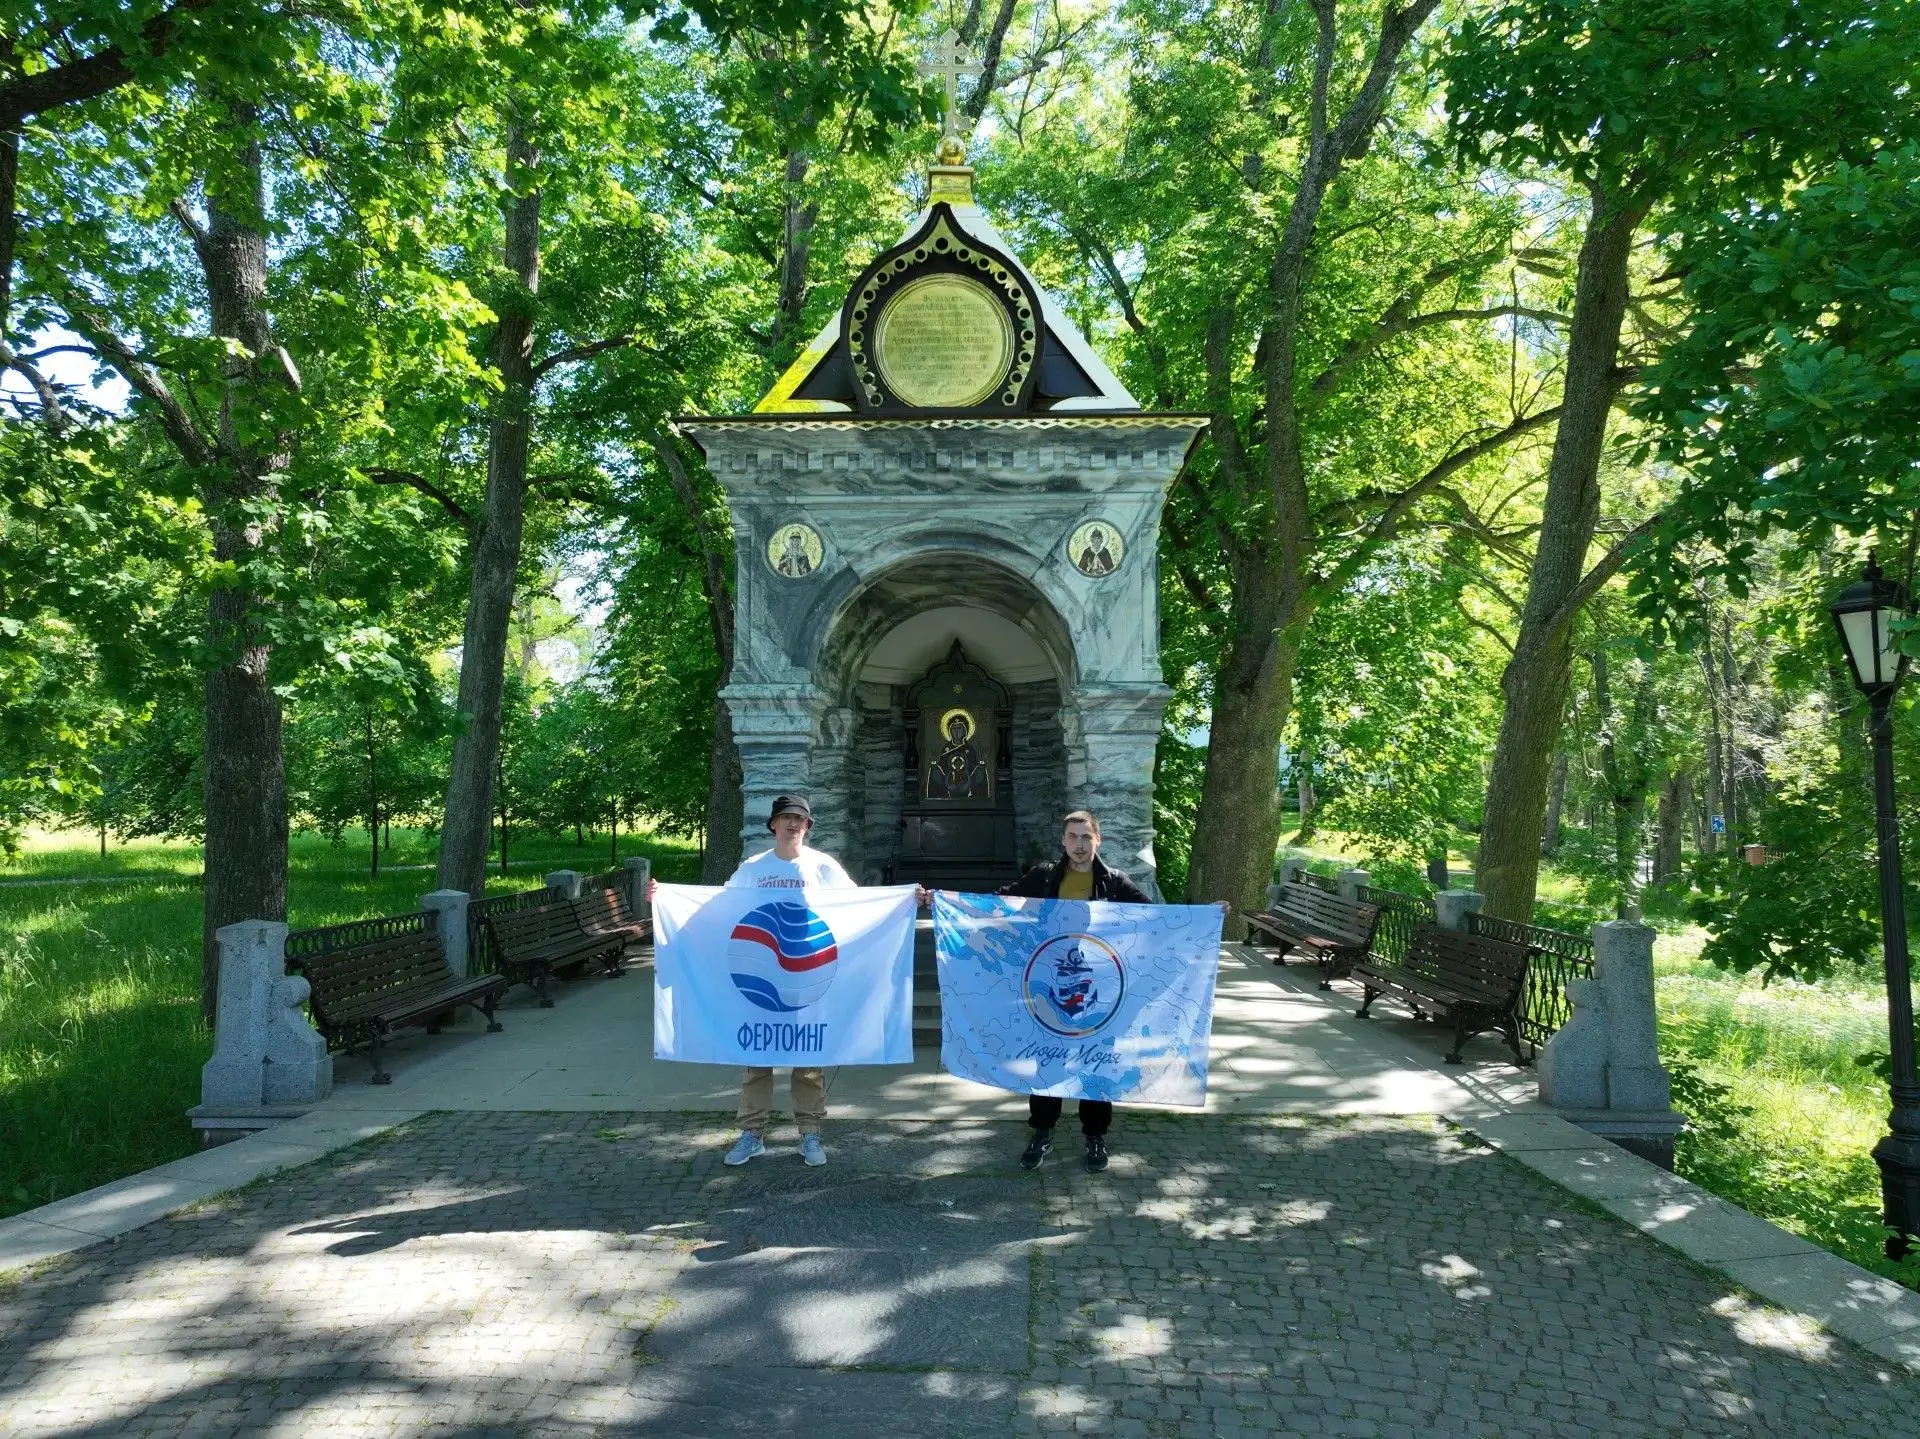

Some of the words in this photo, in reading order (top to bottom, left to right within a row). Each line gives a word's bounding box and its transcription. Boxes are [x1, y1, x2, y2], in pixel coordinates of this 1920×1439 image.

[758, 879, 812, 888] MOUNTAI
[737, 1022, 828, 1052] ФЕРТОИНГ
[1015, 1041, 1071, 1067] Люди
[1062, 1043, 1121, 1073] Моря
